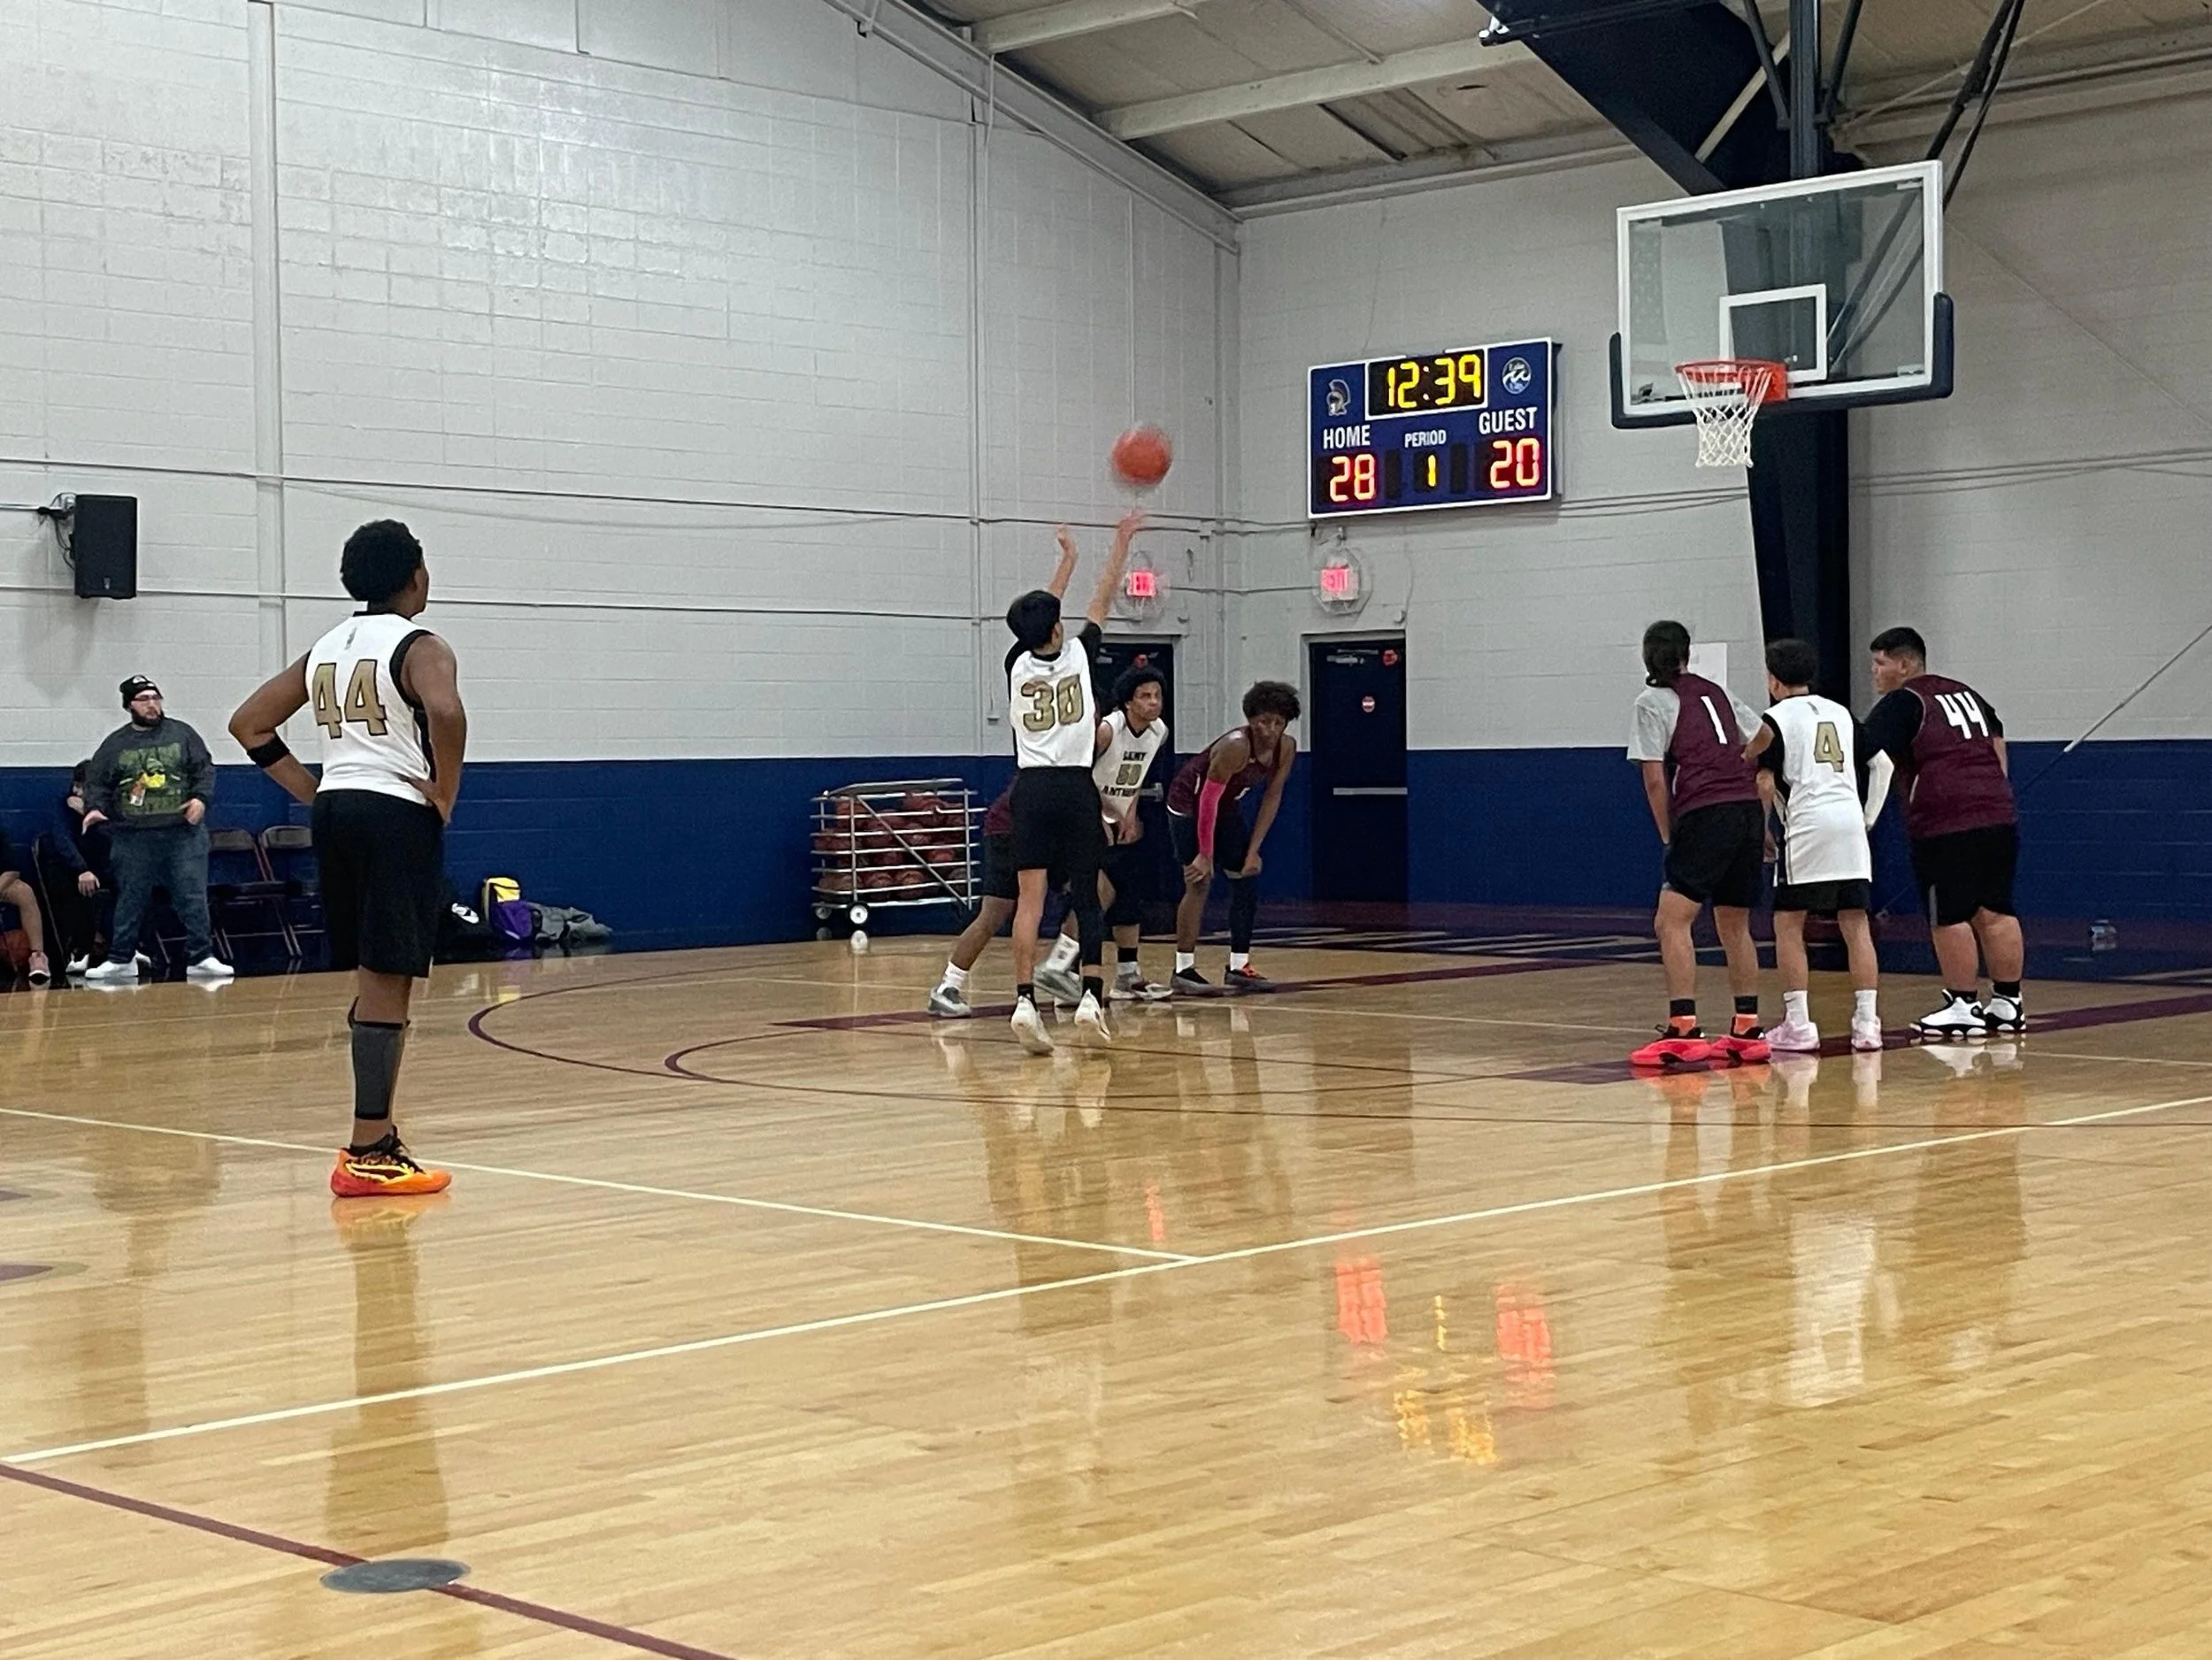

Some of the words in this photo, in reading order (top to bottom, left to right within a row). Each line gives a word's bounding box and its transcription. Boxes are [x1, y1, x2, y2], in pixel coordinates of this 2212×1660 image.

[1387, 354, 1481, 408] 12:39
[1323, 425, 1371, 450] HOME
[1404, 430, 1447, 448] PERIOD
[1479, 407, 1538, 434] GUEST
[1330, 454, 1375, 503] 28
[1427, 455, 1437, 487] 1
[1490, 438, 1540, 488] 20
[312, 659, 388, 740] 44
[1021, 674, 1084, 732] 30
[1700, 696, 1728, 744] 1
[1934, 691, 1989, 739] 44
[1814, 721, 1845, 772] 4
